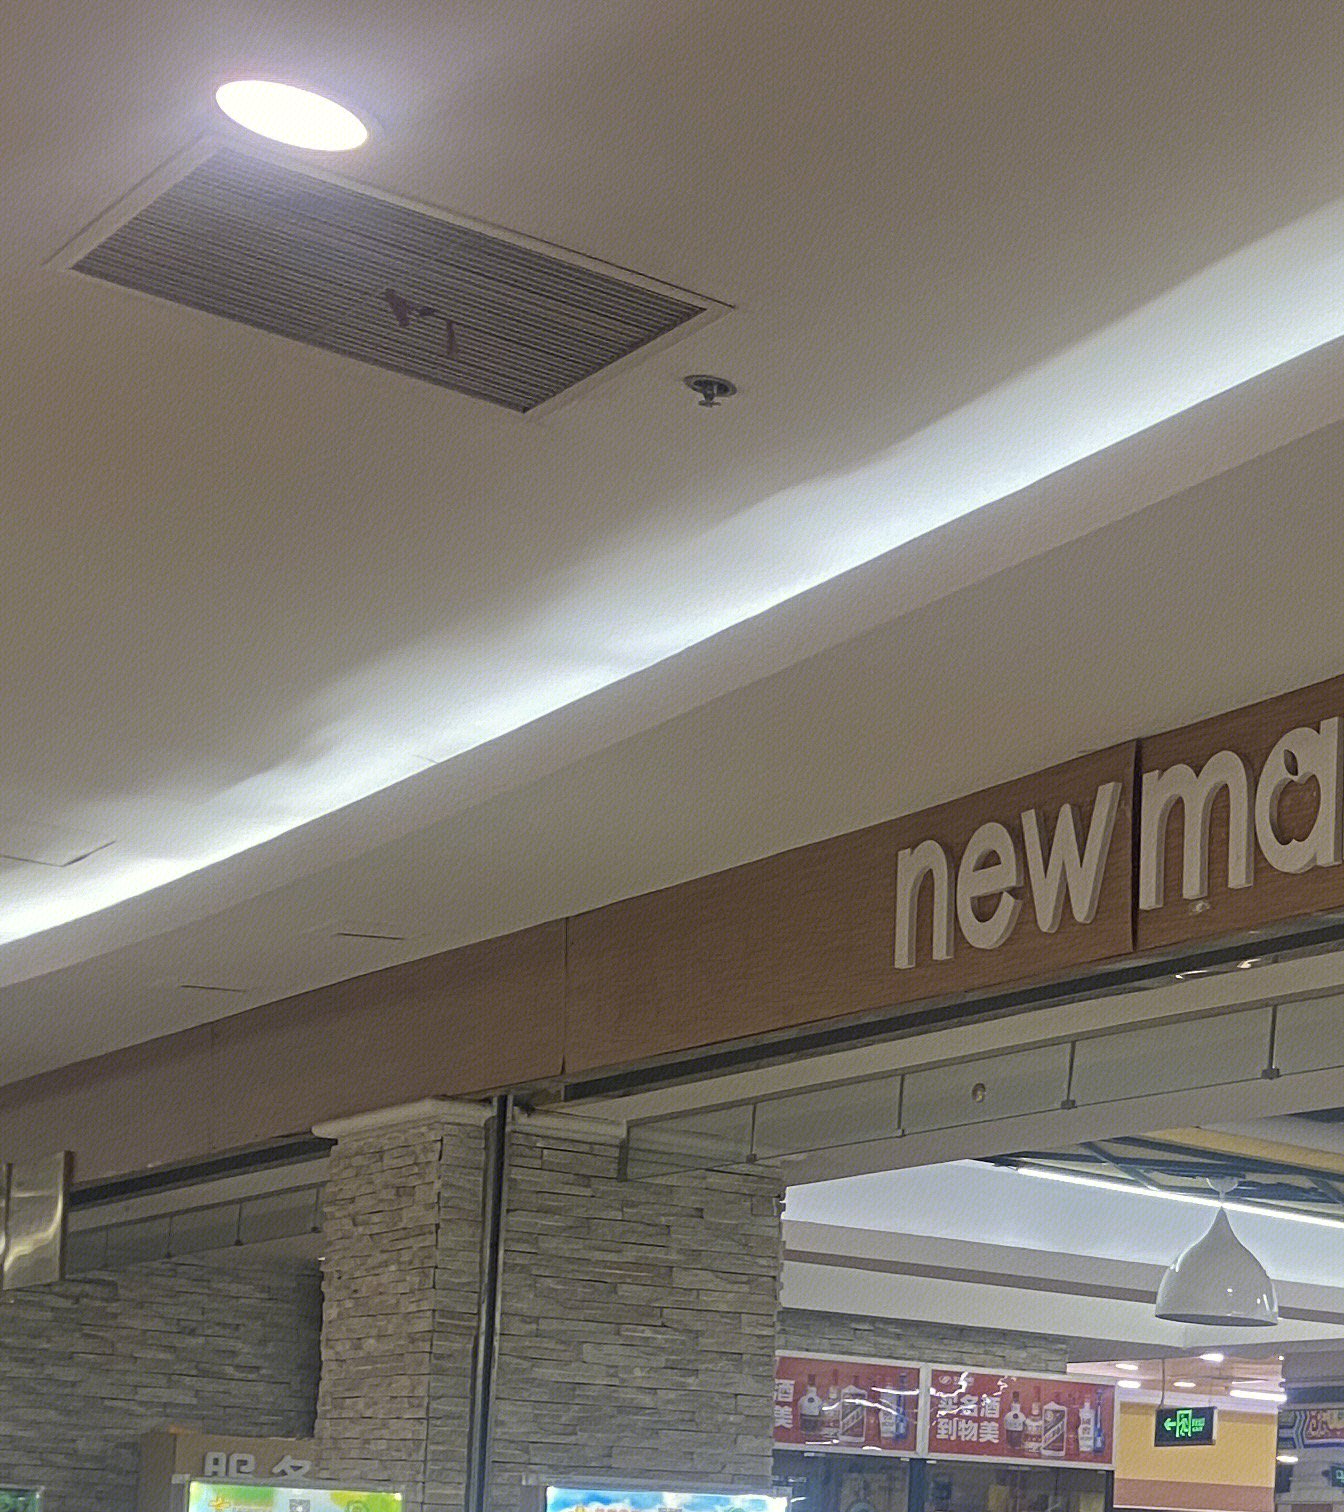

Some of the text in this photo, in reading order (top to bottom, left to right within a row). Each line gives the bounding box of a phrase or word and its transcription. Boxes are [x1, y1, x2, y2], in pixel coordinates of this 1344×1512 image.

[893, 781, 1121, 969] new
[936, 1421, 1000, 1444] 到物美
